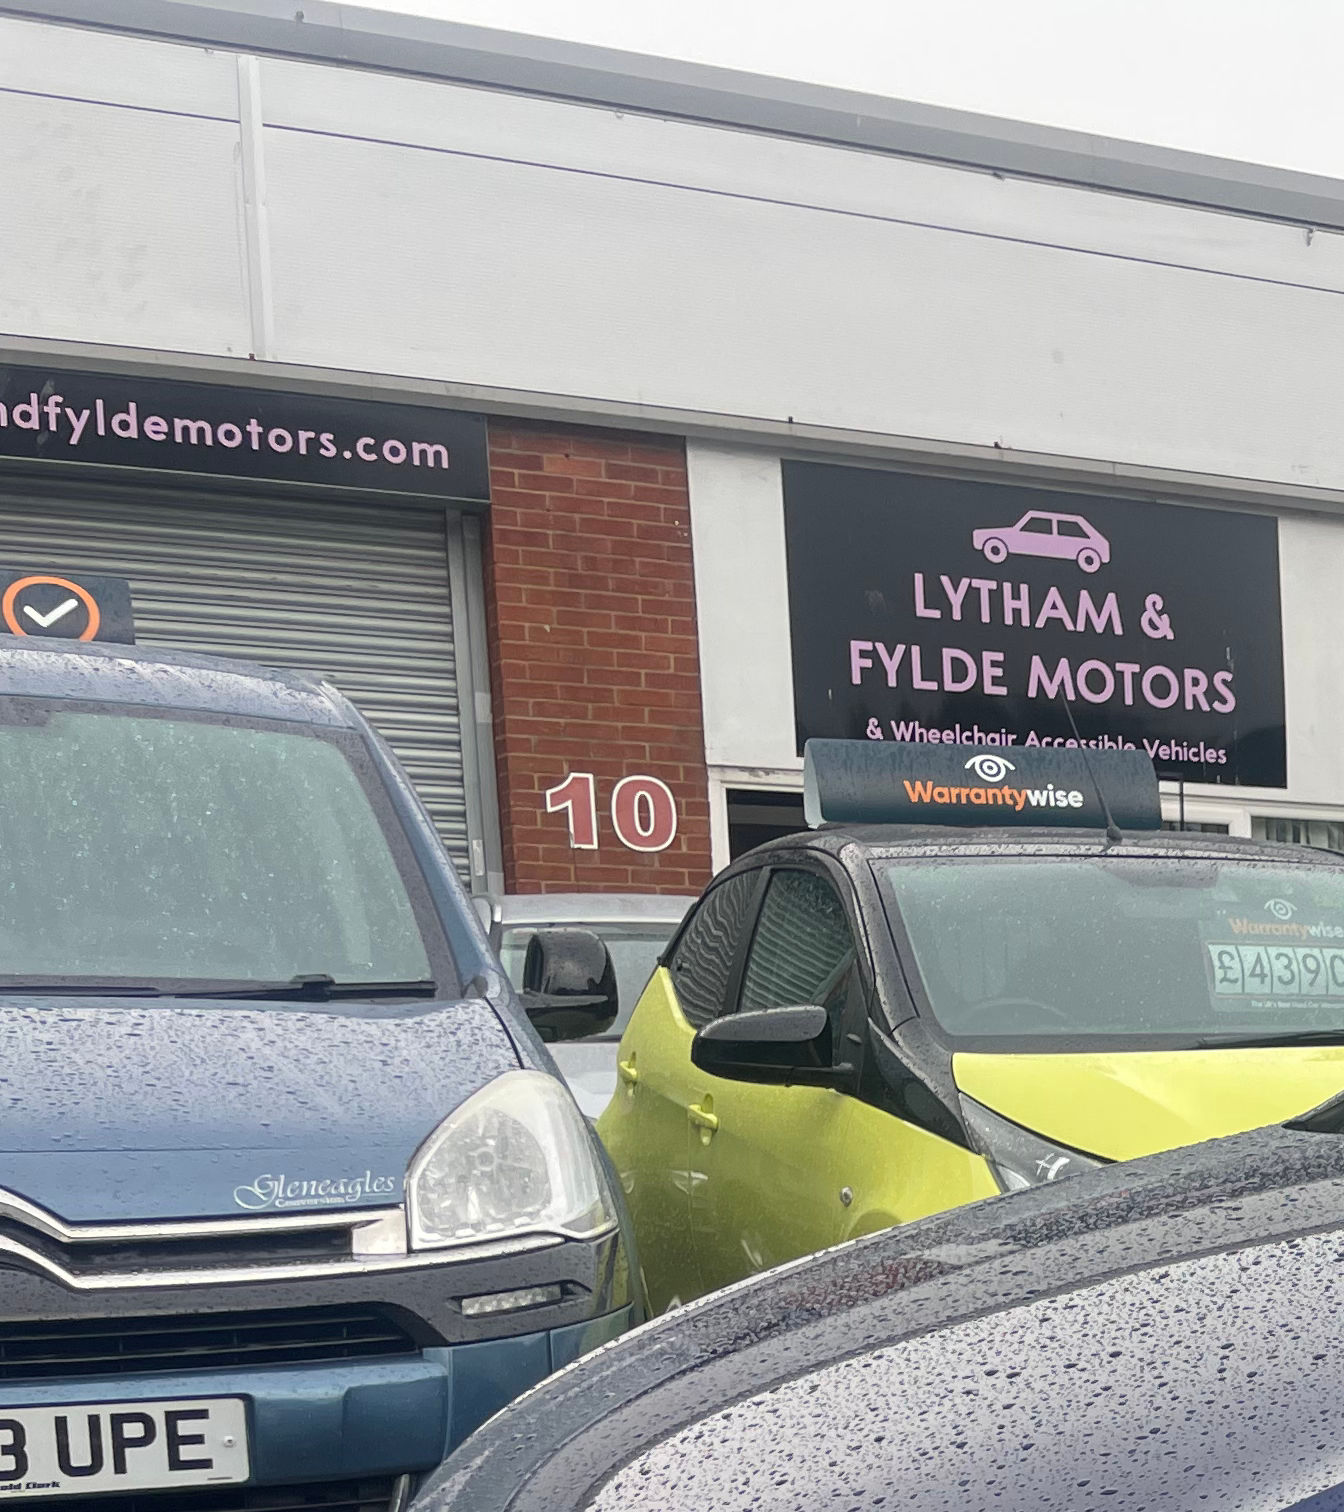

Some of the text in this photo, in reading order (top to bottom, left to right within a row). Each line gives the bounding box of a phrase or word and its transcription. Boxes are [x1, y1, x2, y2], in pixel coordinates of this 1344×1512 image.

[914, 572, 1175, 640] LYTHAM &
[849, 640, 1237, 714] FYLDE MOTORS
[866, 717, 884, 741] &
[890, 720, 1017, 746] Wheelchair
[1143, 738, 1228, 765] Vehicles
[545, 772, 678, 852] 10
[903, 779, 1084, 811] Warrantywise
[1229, 918, 1344, 940] Warrantywise
[233, 1170, 396, 1210] Gleneagles
[54, 1408, 215, 1478] UPE
